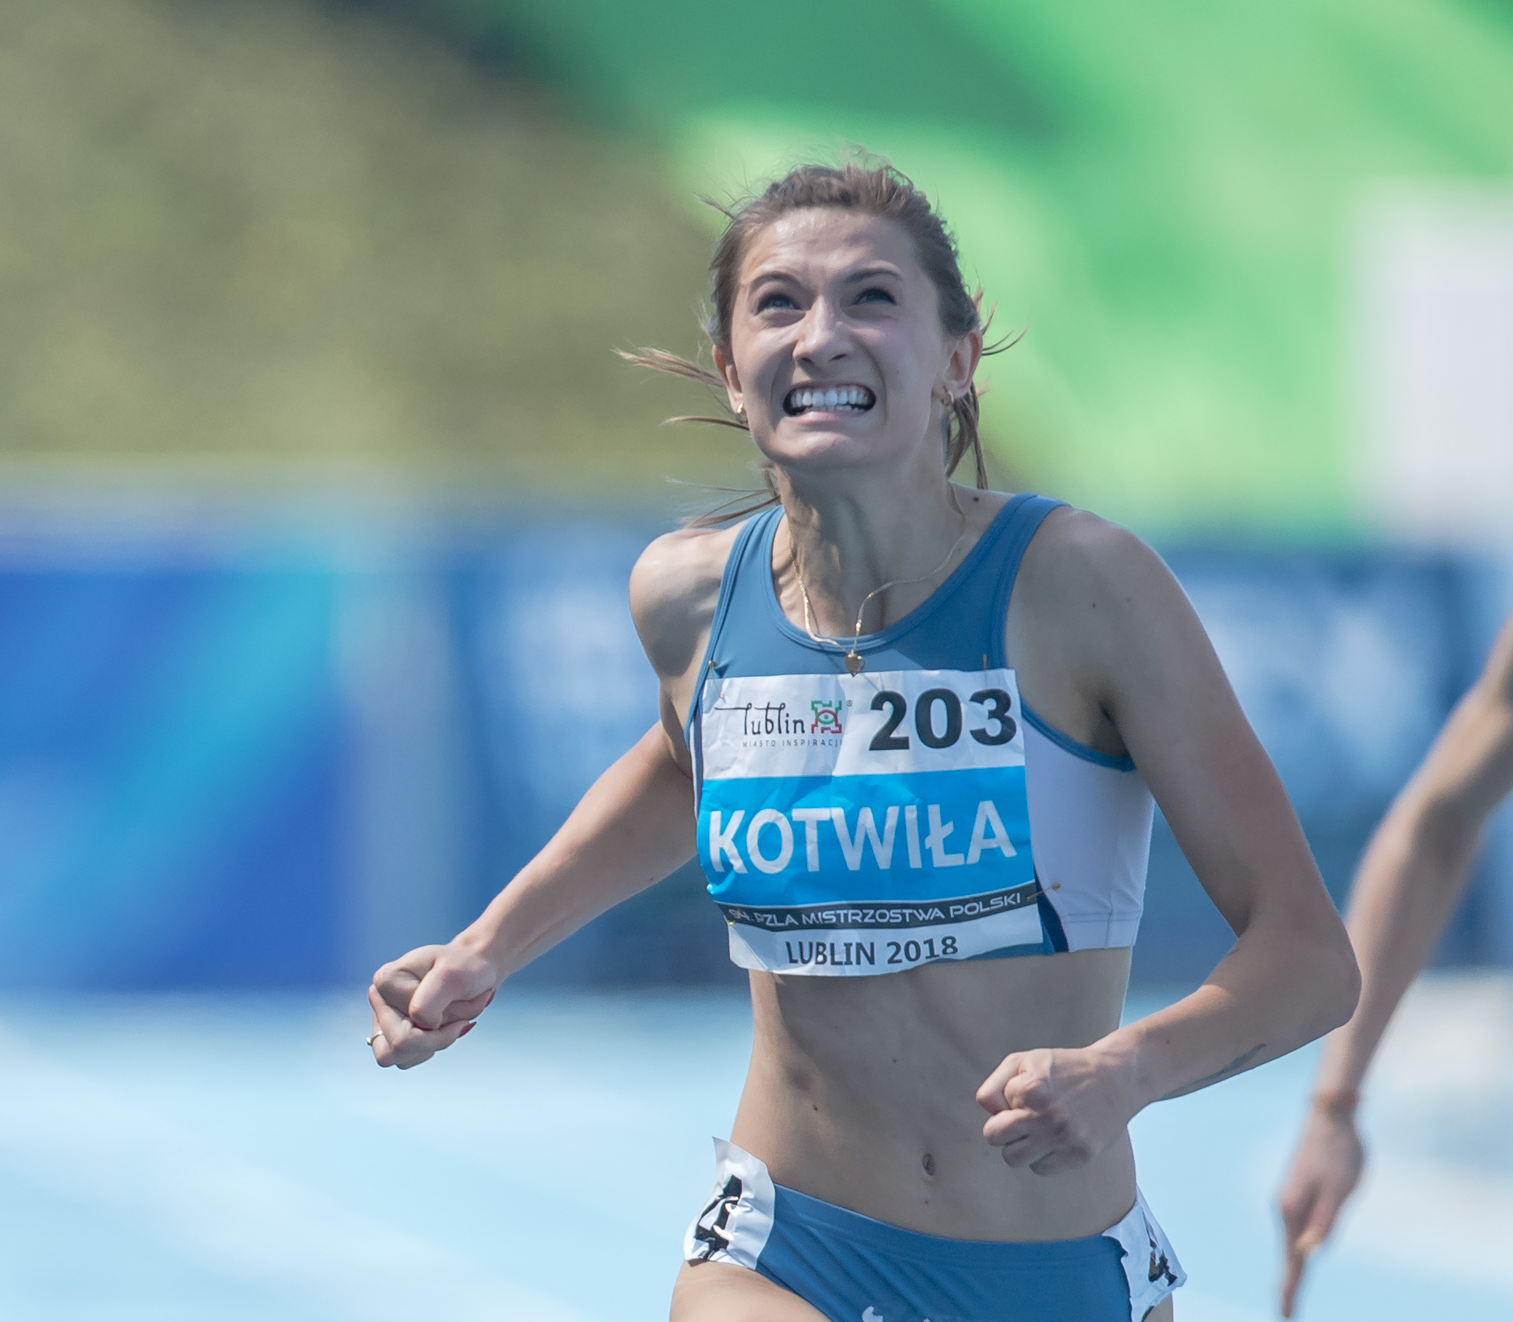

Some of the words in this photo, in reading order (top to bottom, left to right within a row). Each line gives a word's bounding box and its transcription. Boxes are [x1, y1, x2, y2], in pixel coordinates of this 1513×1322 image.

[869, 688, 1017, 752] 203
[742, 739, 776, 748] MIASTO
[782, 738, 842, 748] INSPIRACJI
[709, 800, 1017, 874] KOTWIŁA
[754, 912, 799, 927] PZLA
[802, 908, 945, 925] MISTRZOSTWA
[949, 892, 1022, 918] POLSKI
[785, 940, 875, 966] LUBLIN
[886, 935, 959, 965] 2018
